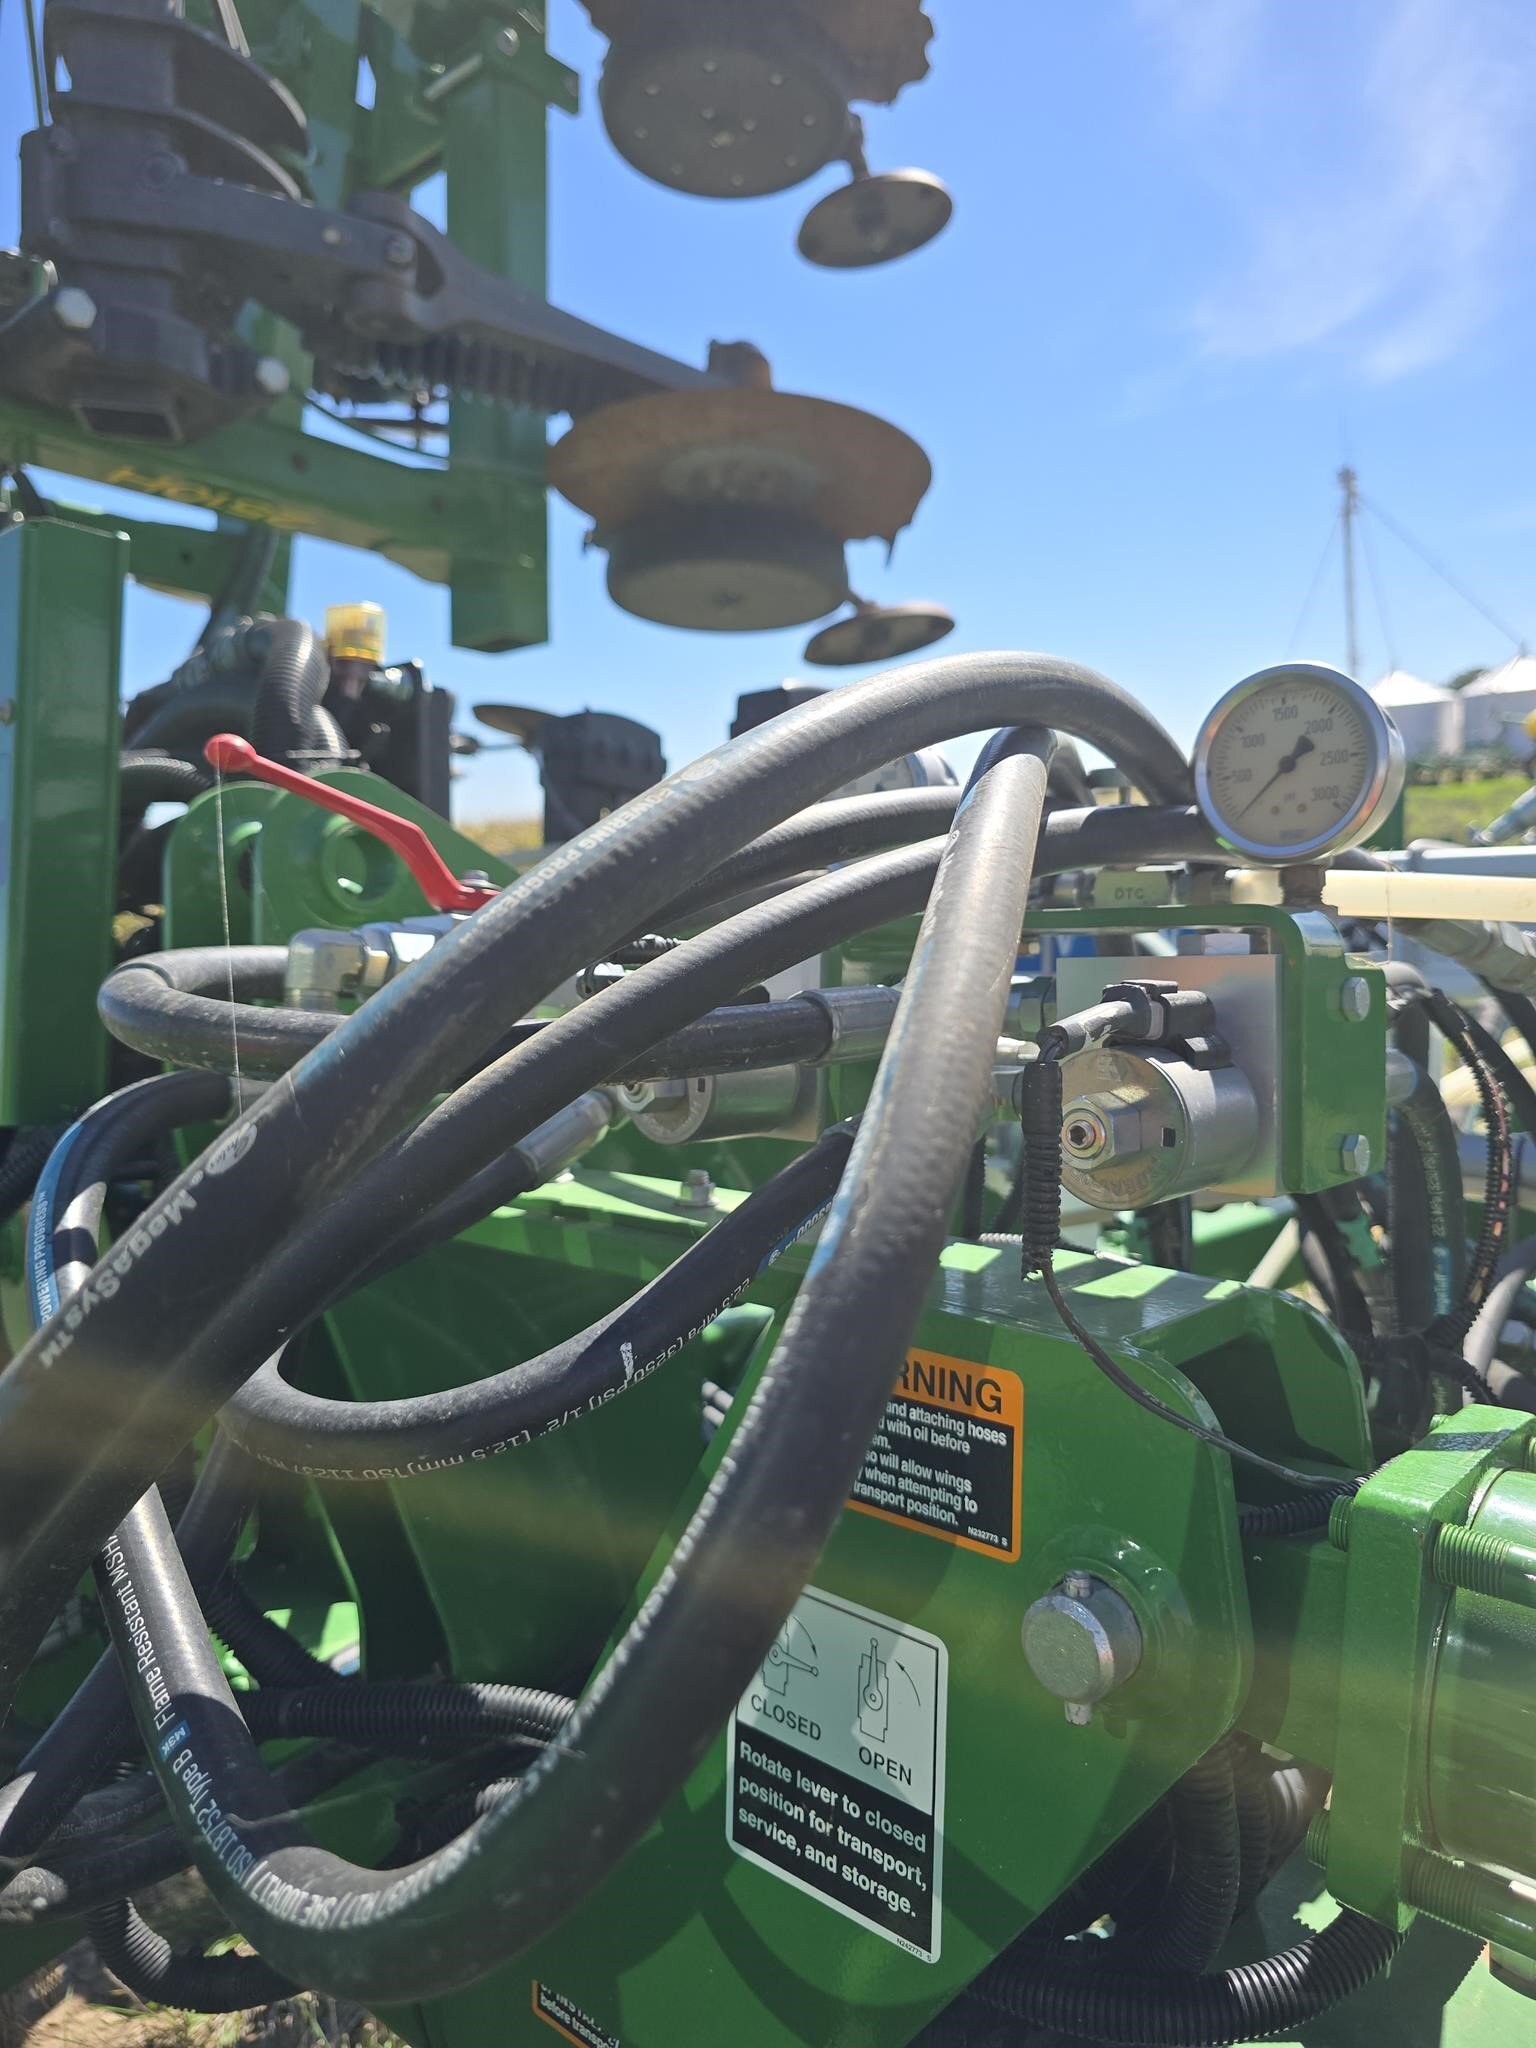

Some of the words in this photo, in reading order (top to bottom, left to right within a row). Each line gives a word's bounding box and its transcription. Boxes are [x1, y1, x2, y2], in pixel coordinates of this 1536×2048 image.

[1272, 705, 1298, 721] 1500
[1304, 718, 1333, 736] 2000
[1320, 751, 1348, 766] 2500
[1114, 887, 1145, 900] DTC
[34, 1256, 53, 1323] POWERING
[886, 1401, 907, 1418] and
[909, 1406, 965, 1437] attaching
[967, 1420, 1008, 1446] hoses
[886, 1419, 912, 1437] with
[913, 1425, 929, 1441] oil
[930, 1431, 971, 1455] before
[865, 1467, 896, 1486] when
[898, 1477, 962, 1511] attempting
[964, 1496, 978, 1514] to
[880, 1452, 899, 1469] will
[901, 1460, 933, 1479] allow
[934, 1470, 972, 1493] wings
[853, 1480, 905, 1508] transport
[907, 1499, 959, 1526] position.
[116, 1580, 157, 1673] Resistant
[146, 1666, 176, 1731] Flame
[751, 1693, 822, 1742] CLOSED
[161, 1726, 187, 1755] M3K
[172, 1748, 193, 1775] B
[182, 1763, 213, 1815] Type
[858, 1746, 912, 1786] OPEN
[739, 1741, 793, 1784] Rotate
[796, 1770, 838, 1807] lever
[842, 1795, 861, 1818] to
[865, 1809, 926, 1853] closed
[197, 1798, 238, 1860] 18752
[739, 1775, 804, 1823] position
[809, 1809, 834, 1836] for
[837, 1824, 927, 1890] transport,
[738, 1807, 801, 1856] service,
[805, 1843, 837, 1875] and
[841, 1862, 917, 1918] storage.
